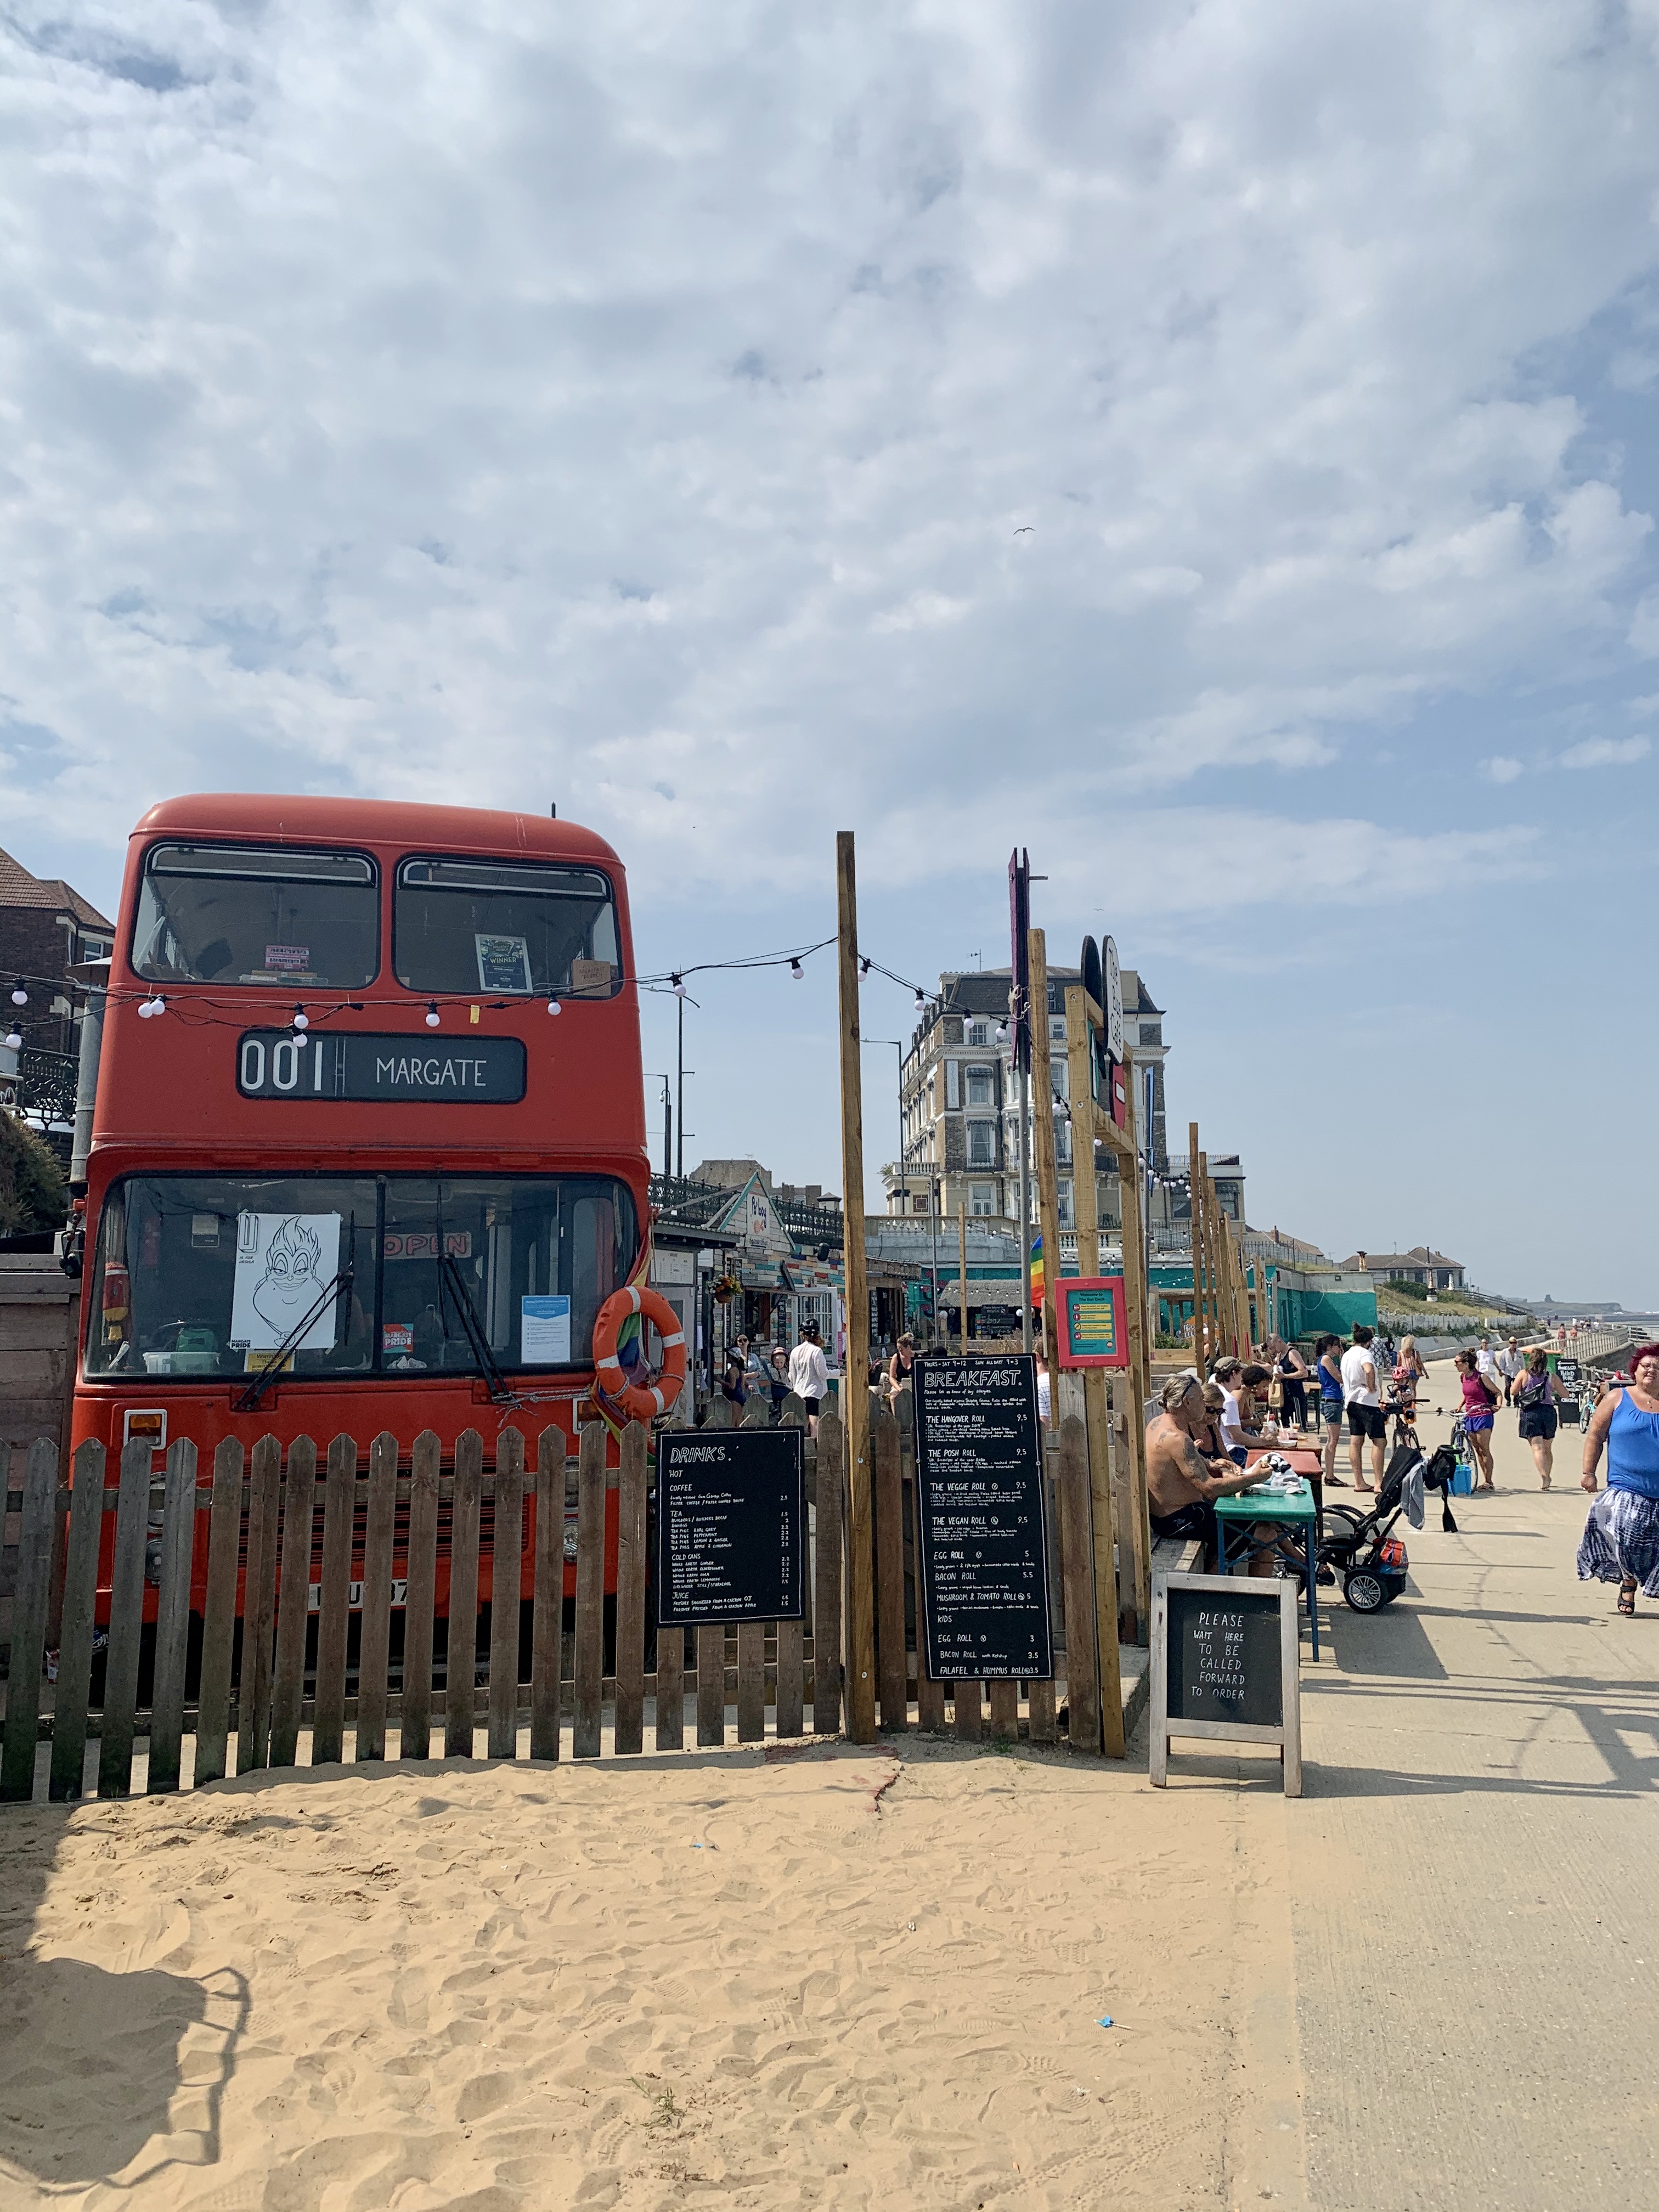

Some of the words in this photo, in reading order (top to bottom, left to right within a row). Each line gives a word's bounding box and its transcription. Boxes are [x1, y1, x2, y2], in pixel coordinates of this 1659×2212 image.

[1108, 947, 1118, 985] The
[1112, 985, 1121, 1019] Bus
[241, 1039, 323, 1091] 001
[376, 1057, 487, 1087] MARGATE
[239, 1214, 259, 1252] U
[384, 1234, 467, 1256] OPEN
[926, 1415, 940, 1424] THE
[928, 1449, 941, 1457] THE
[669, 1470, 683, 1478] HOT
[932, 1516, 945, 1525] THE
[948, 1516, 969, 1525] VEGAN
[971, 1516, 986, 1525] ROLL
[934, 1551, 947, 1560] EGG
[935, 1572, 956, 1581] BACON
[962, 1572, 976, 1580] ROLL
[936, 1593, 968, 1601] MUSHROOM
[977, 1592, 1000, 1600] TOMATO
[1003, 1592, 1017, 1600] ROLL
[938, 1615, 952, 1623] KIDS
[1199, 1612, 1244, 1627] PLEASE
[938, 1634, 951, 1643] EGG
[957, 1634, 972, 1642] ROLL
[1193, 1630, 1212, 1640] WAIT
[1224, 1632, 1244, 1641] HERE
[1199, 1643, 1212, 1655] TO
[1225, 1645, 1239, 1656] BE
[1200, 1658, 1242, 1670] CALLED
[1199, 1671, 1245, 1684] FORWARD
[1191, 1686, 1203, 1696] TO
[1212, 1688, 1245, 1700] ORDER
